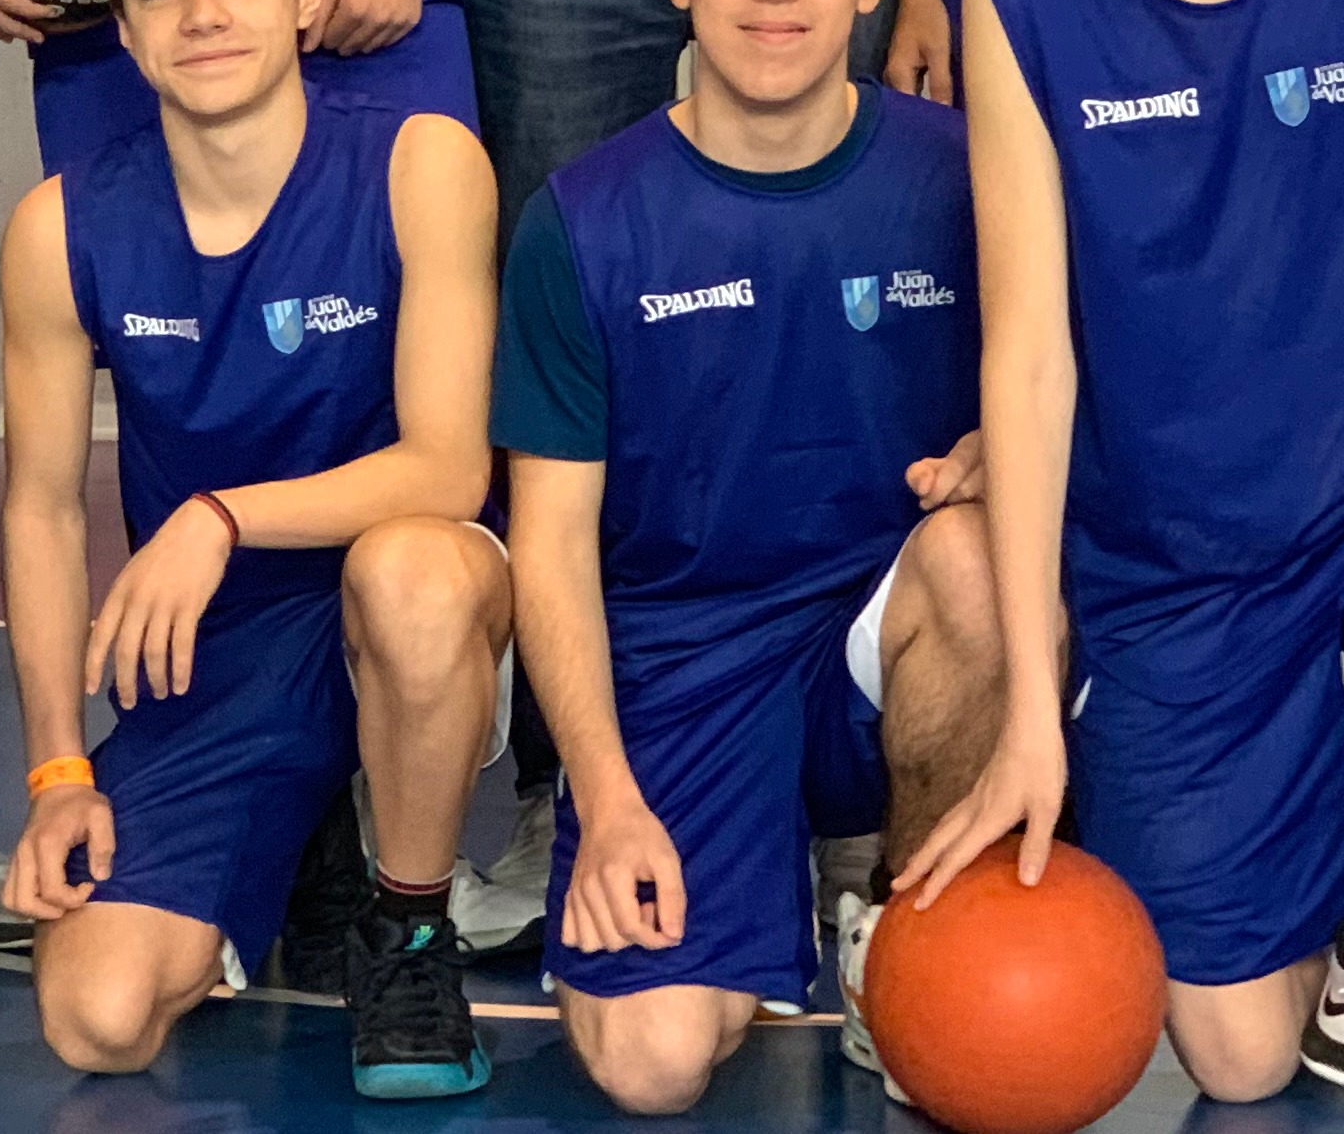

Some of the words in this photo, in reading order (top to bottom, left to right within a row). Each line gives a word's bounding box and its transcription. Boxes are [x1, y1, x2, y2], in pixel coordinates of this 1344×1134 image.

[1080, 86, 1201, 130] SPALDING
[886, 271, 935, 290] Juan
[304, 296, 350, 319] Juan
[639, 277, 755, 324] SPALDING
[898, 286, 956, 308] Valdés
[314, 304, 379, 334] Valdés
